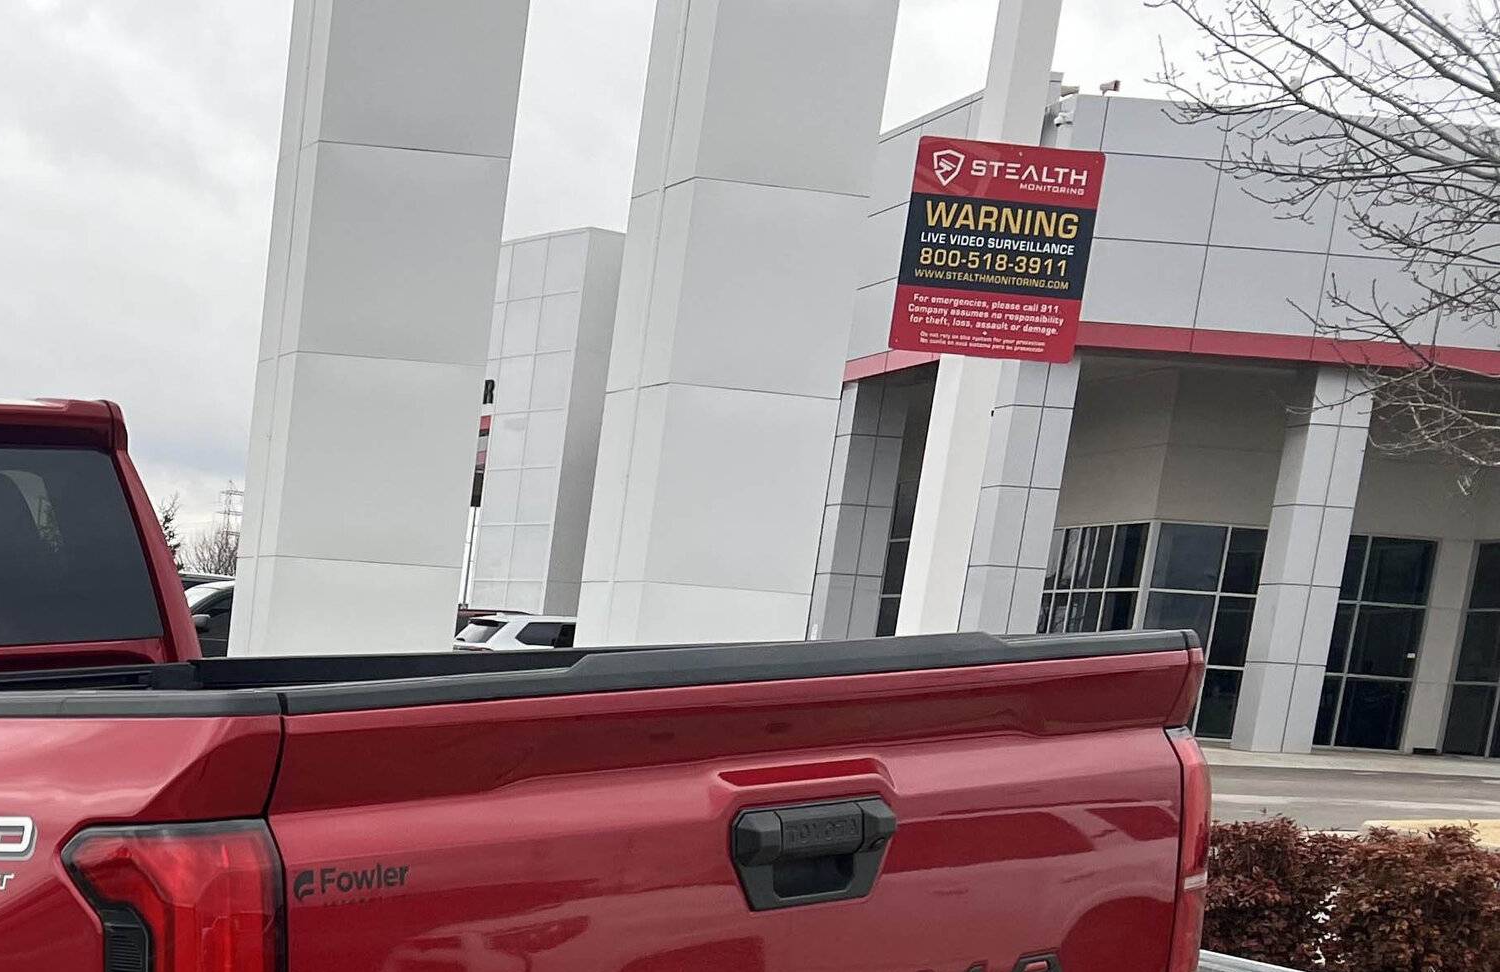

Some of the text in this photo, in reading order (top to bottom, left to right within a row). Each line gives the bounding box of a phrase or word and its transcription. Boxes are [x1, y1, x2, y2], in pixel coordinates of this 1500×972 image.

[971, 159, 1088, 185] STEALTH
[1019, 183, 1085, 196] MONITORING
[926, 200, 1080, 239] WARNING
[920, 231, 1075, 256] LIVE VIDEO SURVEILLANCE
[919, 247, 1067, 277] 800-518-3911
[914, 268, 1070, 290] WWW.STEALTHMONITORING.COM
[908, 303, 1064, 326] Company assumes no responsibility
[913, 293, 929, 302] For
[931, 296, 989, 309] emergencies,
[991, 301, 1020, 312] please
[1022, 303, 1039, 312] call
[909, 313, 923, 323] for
[925, 315, 950, 327] theft,
[952, 318, 973, 328] loss,
[975, 322, 1008, 331] assault
[1022, 323, 1059, 337] damage.
[320, 862, 411, 895] Fowler
